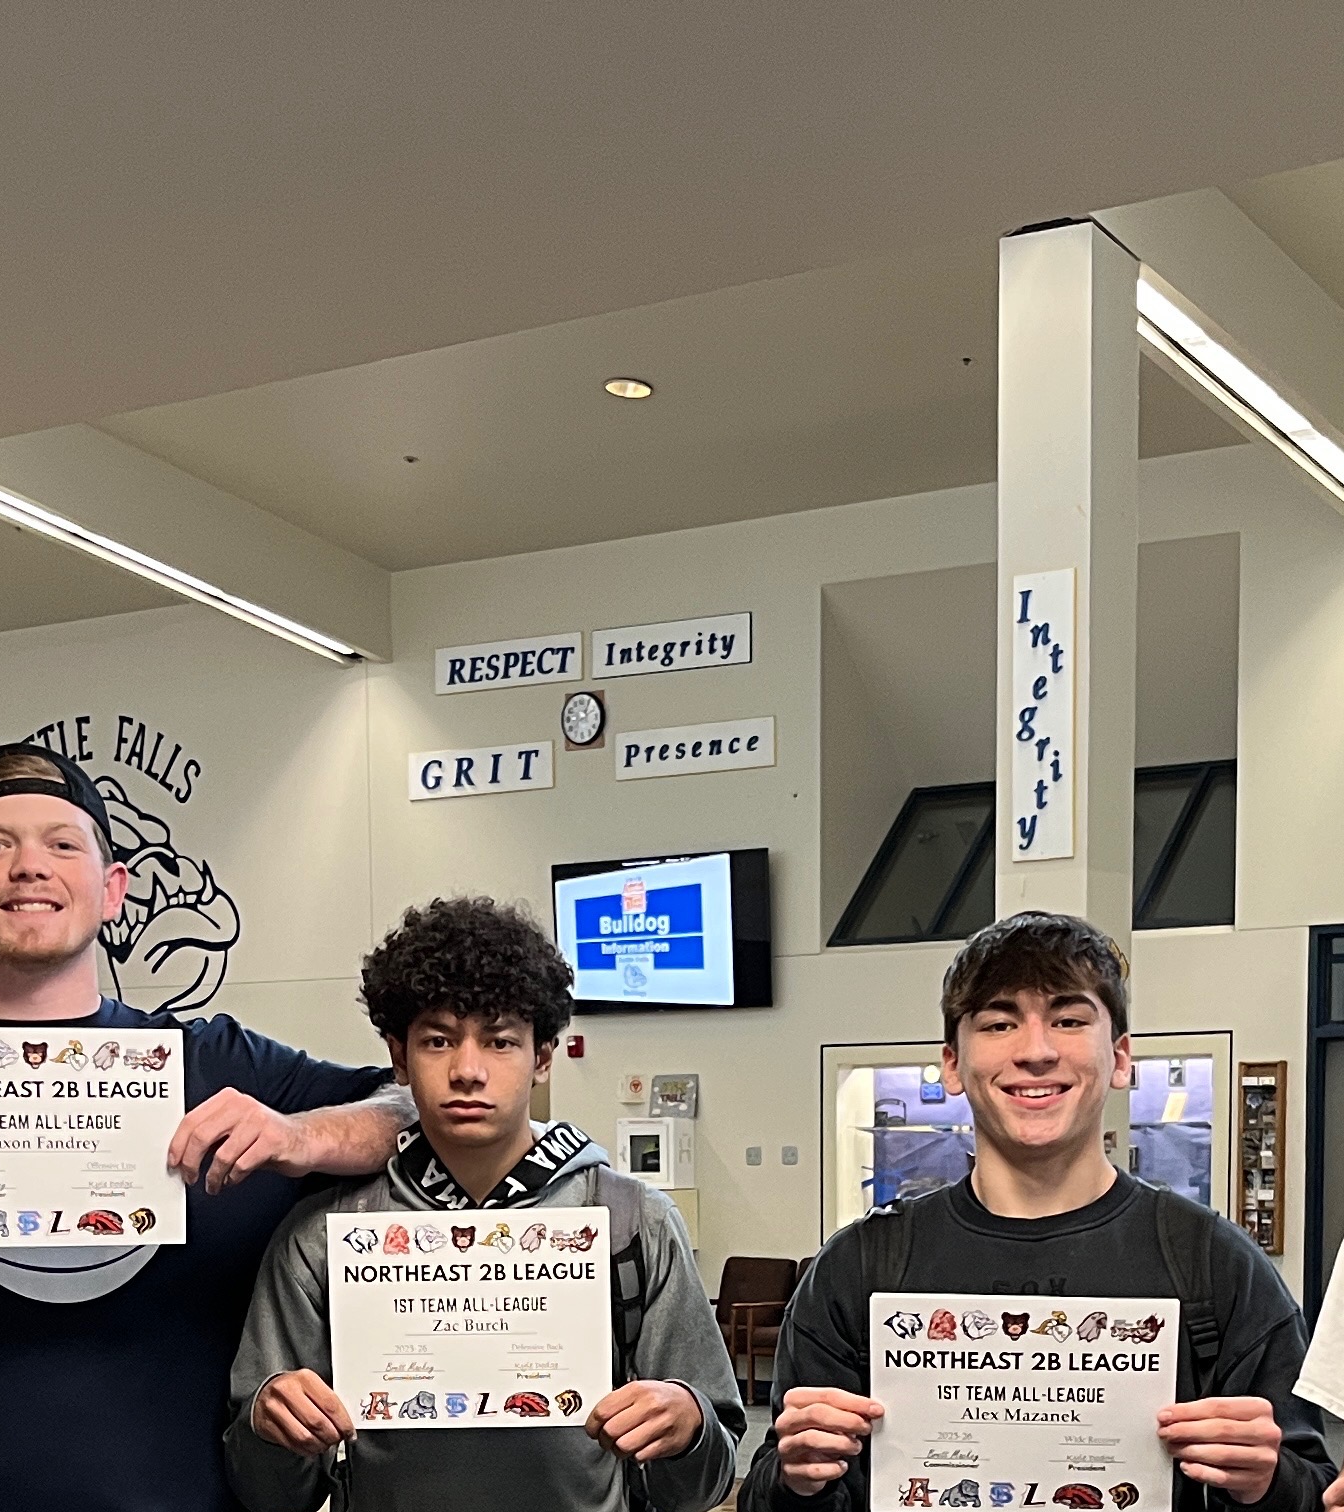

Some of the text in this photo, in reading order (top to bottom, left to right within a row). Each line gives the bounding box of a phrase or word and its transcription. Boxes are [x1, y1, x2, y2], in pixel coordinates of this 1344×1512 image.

[605, 632, 736, 667] Integrity
[446, 647, 575, 685] RESPECT
[1016, 589, 1063, 850] Integrity
[114, 715, 201, 804] FALLS
[623, 734, 760, 768] Presence
[420, 749, 539, 791] GRIT
[599, 914, 671, 936] Bulldog
[601, 941, 670, 955] Information
[52, 1081, 79, 1098] 2B
[87, 1081, 169, 1098] LEAGUE
[35, 1115, 121, 1129] ALL-LEAGUE
[38, 1137, 99, 1153] Fandrey
[525, 1124, 588, 1171] PUMA
[345, 1263, 595, 1283] NORTHEAST 2B LEAGUE
[394, 1297, 547, 1313] 1ST TEAM ALL-LEAGUE
[433, 1318, 508, 1331] Zac Burch
[885, 1350, 1160, 1372] NORTHEAST 2B LEAGUE
[937, 1385, 1105, 1403] 1ST TEAM ALL-LEAGUE
[960, 1407, 1083, 1425] Alex Mazanek
